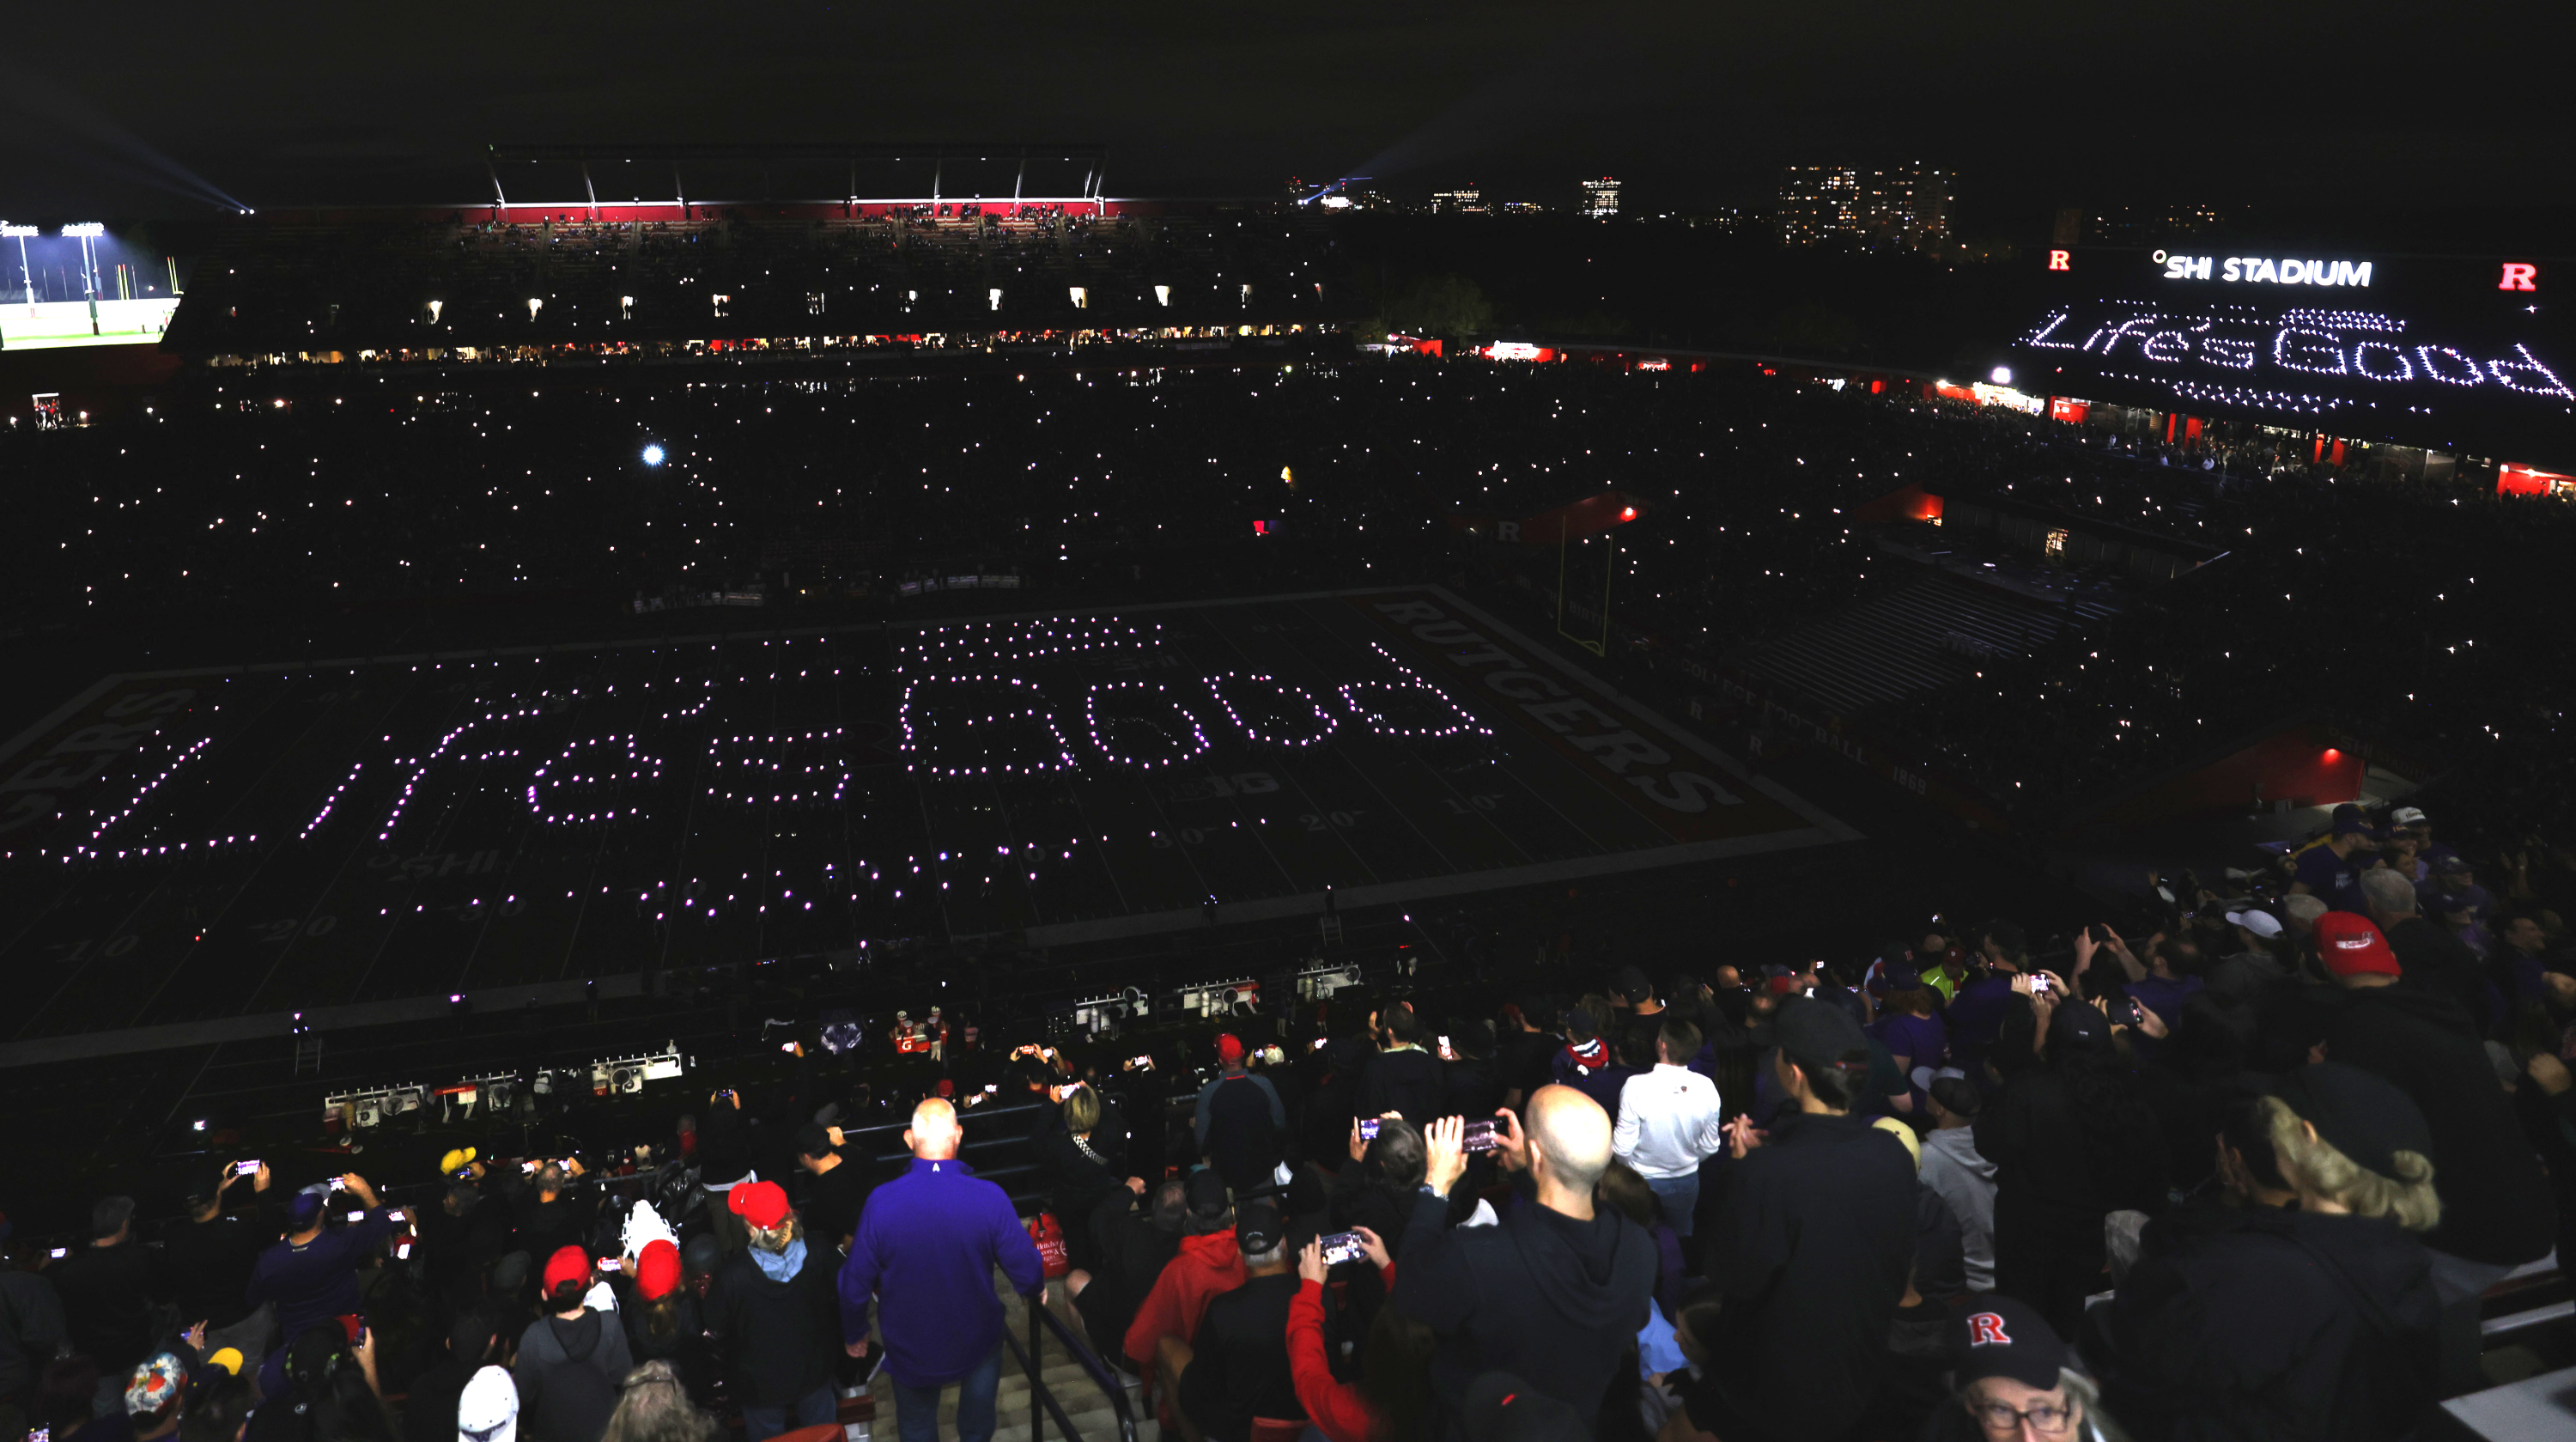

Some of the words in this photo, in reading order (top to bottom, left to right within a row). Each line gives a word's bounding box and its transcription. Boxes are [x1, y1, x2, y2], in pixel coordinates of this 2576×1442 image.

[2049, 250, 2070, 271] R
[2222, 257, 2372, 288] STADIUM
[2499, 262, 2537, 292] R
[2273, 326, 2576, 402] Good
[1374, 599, 1746, 812] RUTGERS
[1966, 1311, 2012, 1347] R
